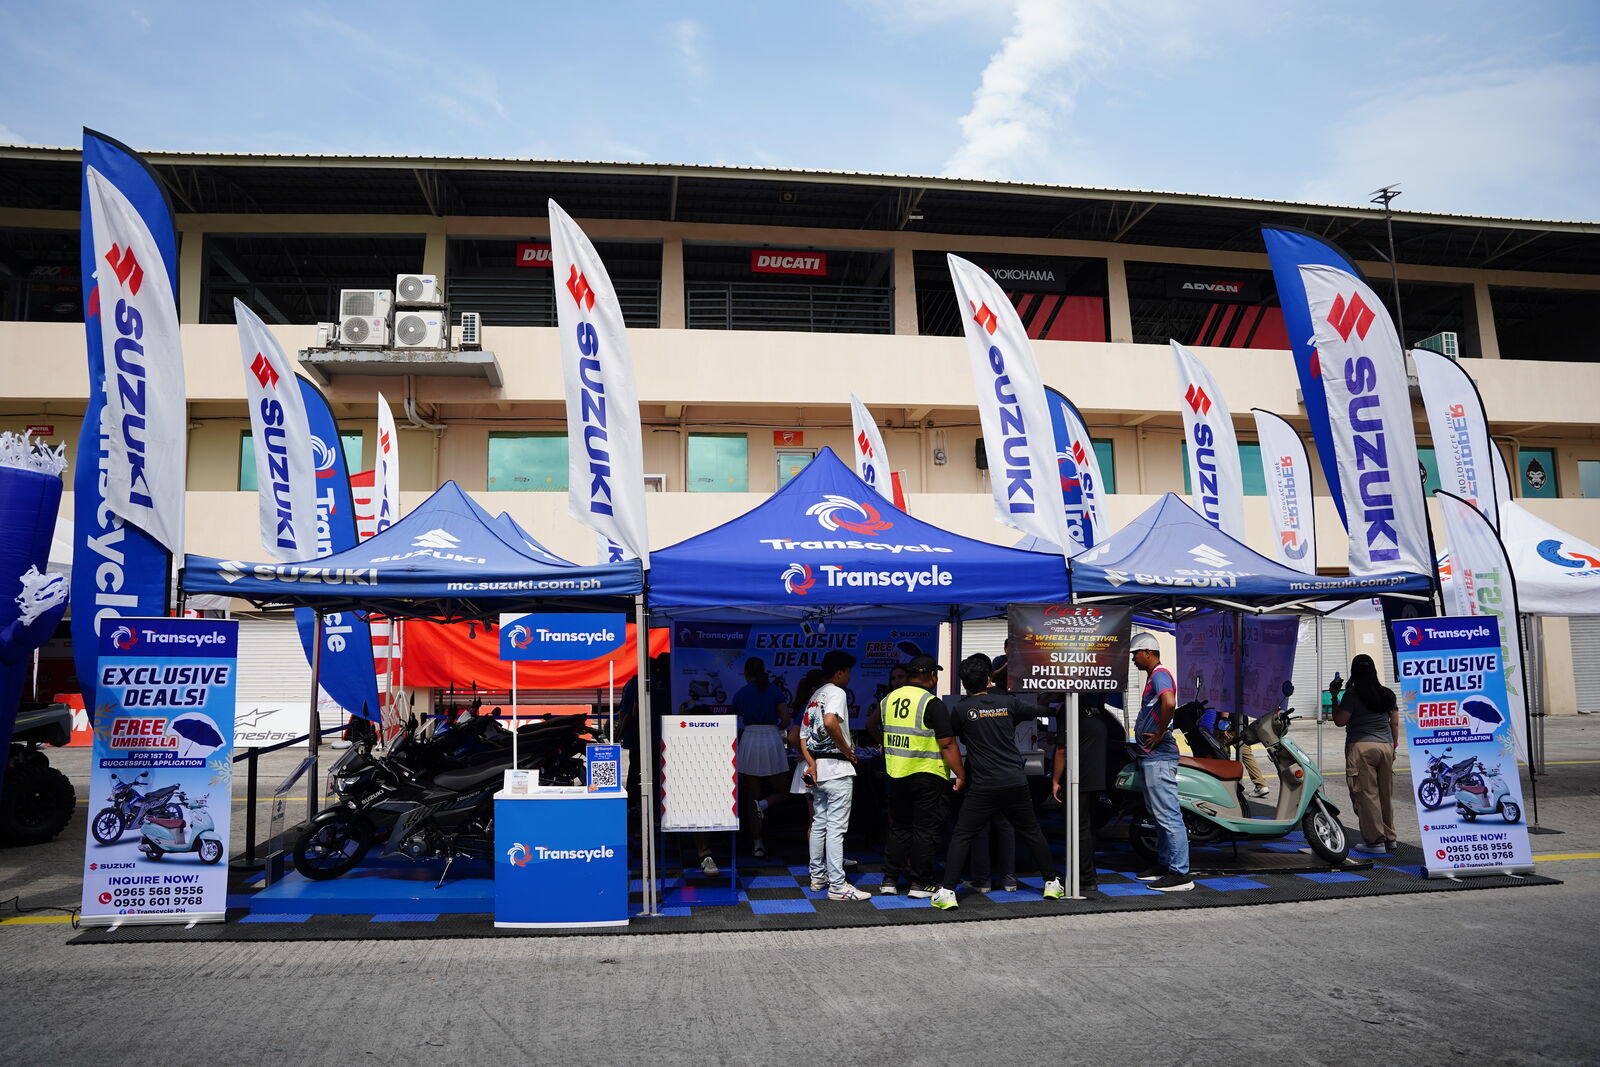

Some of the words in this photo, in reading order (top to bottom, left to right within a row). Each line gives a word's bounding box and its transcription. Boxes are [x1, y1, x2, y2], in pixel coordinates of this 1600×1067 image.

[757, 255, 820, 270] DUCATI
[992, 268, 1055, 281] YOKOHAMA
[1182, 282, 1238, 293] ADVAN
[114, 298, 154, 509] SUZUKI
[576, 321, 614, 517] SUZUKI
[1344, 356, 1401, 563] SUZUKI
[260, 397, 297, 550] SUZUKI
[1194, 422, 1220, 529] SUZU
[759, 538, 954, 554] Transcycle
[369, 549, 486, 564] SUZUKI
[253, 564, 378, 586] SUZUKI
[819, 564, 953, 592] Transcycle
[1134, 572, 1237, 588] SUZUKI
[447, 579, 601, 592] mc.suzuki.com.ph
[1290, 575, 1407, 591] mc.suzuki.com.ph
[142, 630, 227, 647] Transcycle
[535, 628, 615, 645] Transcycle
[695, 629, 745, 642] Transcycle
[756, 632, 858, 649] EXCLUSIVE
[1424, 626, 1490, 640] Transcycle
[866, 641, 893, 652] FREE
[1050, 652, 1097, 663] SUZUKI
[1032, 665, 1112, 677] PHILIPPINES
[1402, 655, 1496, 676] EXCLUSIVE
[102, 667, 229, 685] EXCLUSIVE
[1422, 674, 1483, 693] DEALS!
[1022, 678, 1118, 690] INCORPORATED
[123, 688, 206, 707] DEALS!
[891, 698, 911, 719] 18
[1418, 702, 1457, 717] FREE
[112, 719, 166, 736] FREE
[1419, 717, 1468, 728] UMBRELLA
[112, 737, 177, 748] UMBRELLA
[234, 730, 298, 741] inestars
[887, 733, 910, 748] MEDIA
[361, 789, 385, 805] SUZUKI
[1440, 834, 1478, 844] INQUIRE
[1480, 833, 1507, 841] NOW!
[534, 845, 614, 862] Transcycle
[1446, 844, 1469, 853] 0965
[1471, 843, 1488, 852] 568
[1491, 842, 1513, 851] 9556
[1448, 853, 1472, 862] 0930
[1474, 853, 1490, 861] 601
[1492, 851, 1514, 859] 9768
[108, 875, 160, 885] INQUIRE
[163, 875, 199, 884] NOW!
[113, 887, 145, 896] 0965
[148, 886, 171, 896] 568
[174, 886, 204, 895] 9556
[113, 898, 146, 907] 0930
[150, 897, 170, 906] 601
[173, 896, 203, 905] 9768
